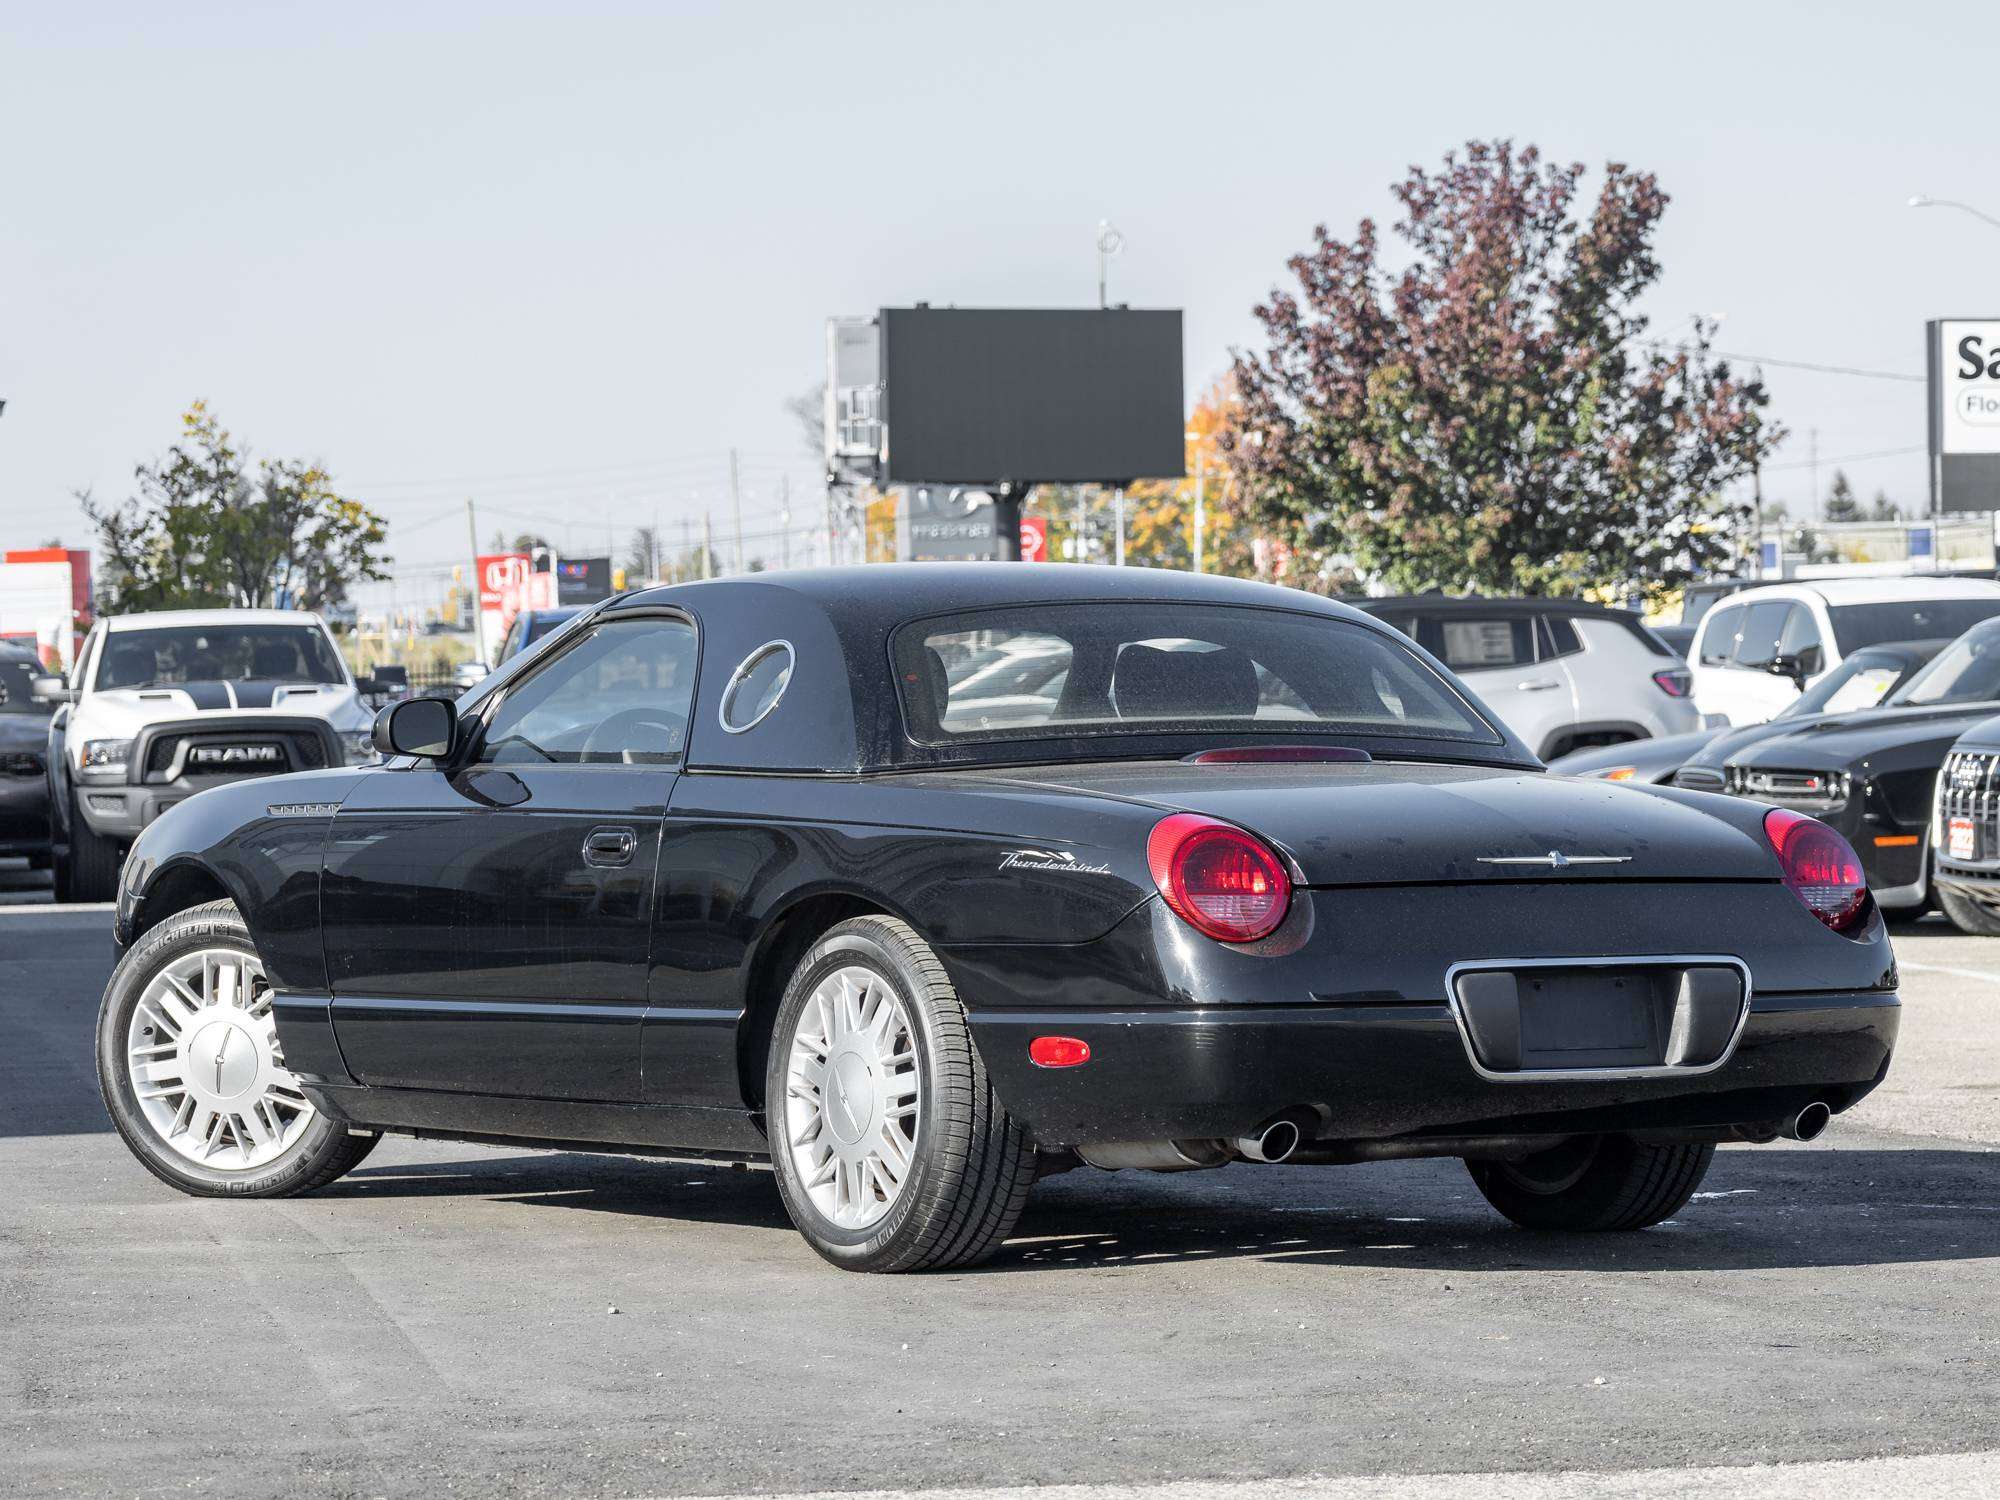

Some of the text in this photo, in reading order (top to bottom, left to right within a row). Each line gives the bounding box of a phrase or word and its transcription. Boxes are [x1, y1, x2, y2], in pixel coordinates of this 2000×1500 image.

[1967, 396, 2000, 411] Flo
[197, 747, 277, 761] RAM
[998, 851, 1111, 874] Thunderbird
[149, 923, 212, 955] MICHELIN
